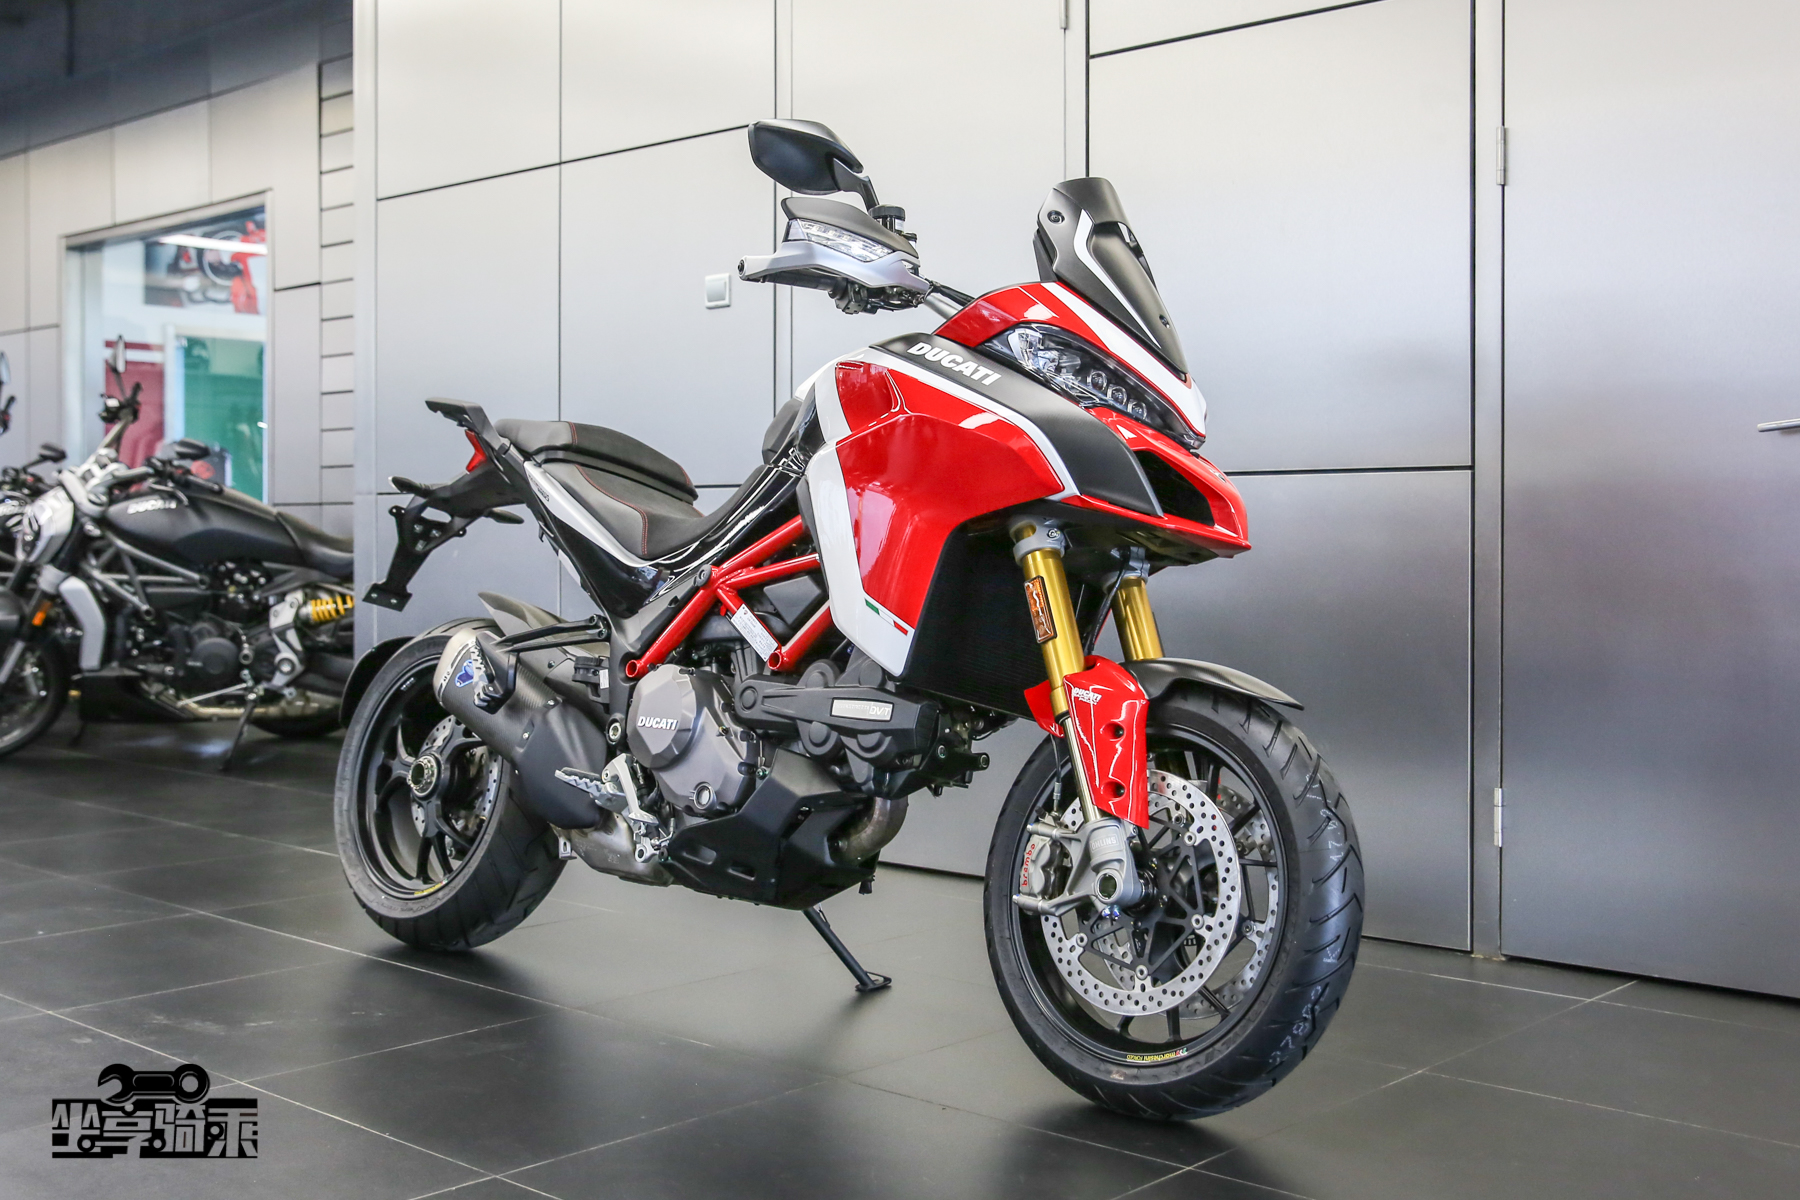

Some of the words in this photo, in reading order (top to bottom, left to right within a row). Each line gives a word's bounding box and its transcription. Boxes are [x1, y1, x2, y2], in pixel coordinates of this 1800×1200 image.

[907, 342, 1002, 386] DUCATI
[637, 715, 678, 731] DUCATI
[1021, 843, 1036, 887] brembo
